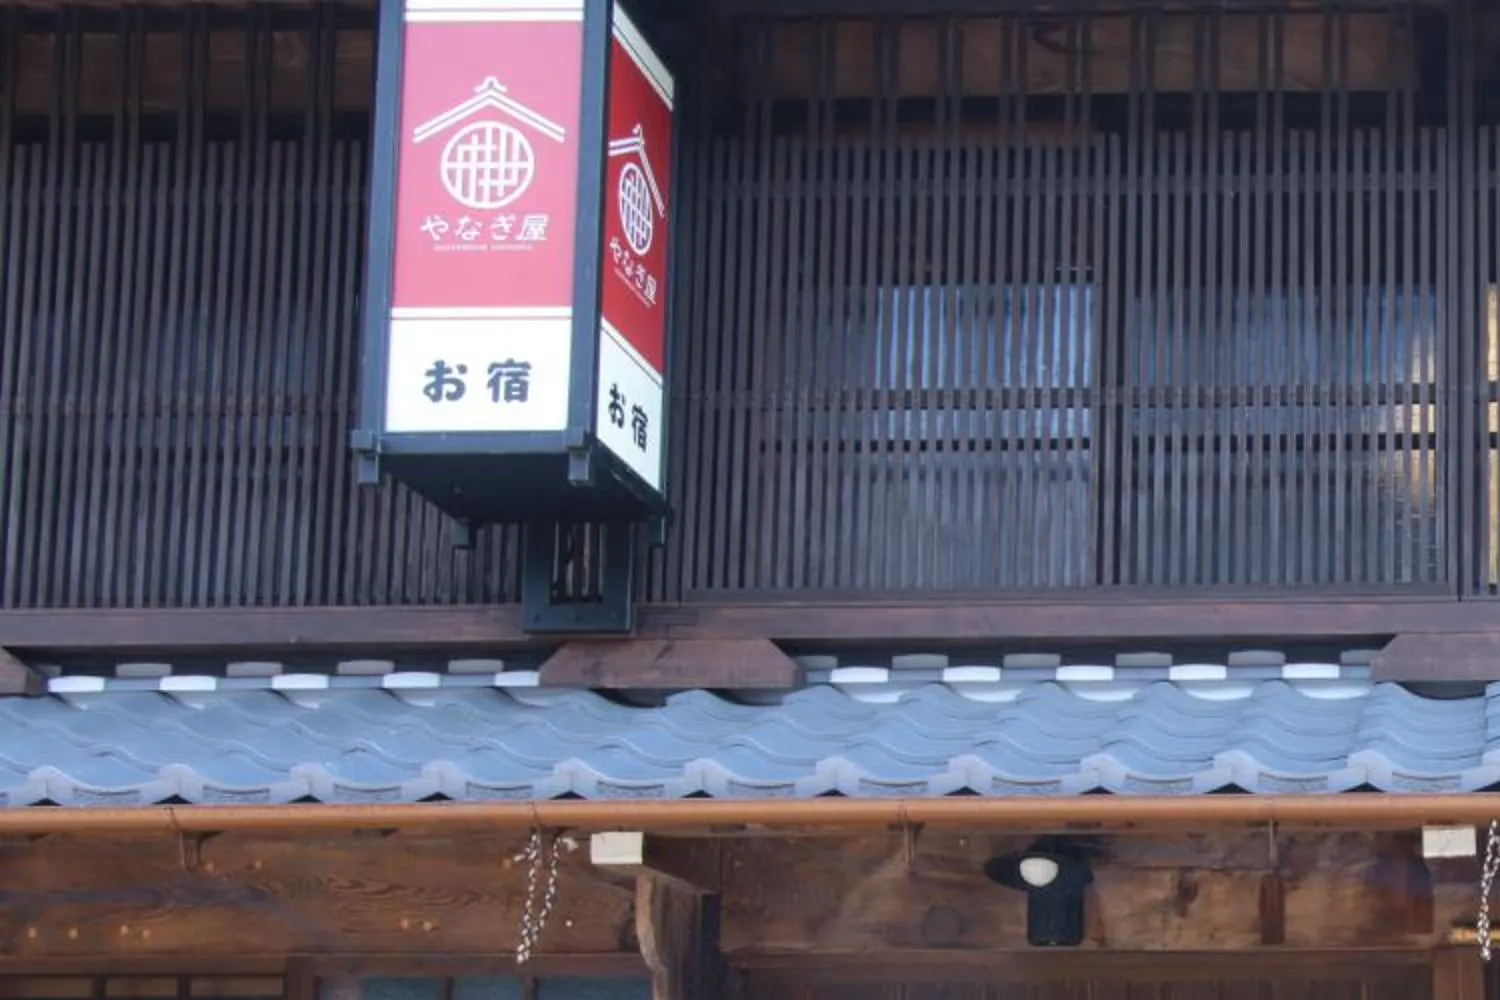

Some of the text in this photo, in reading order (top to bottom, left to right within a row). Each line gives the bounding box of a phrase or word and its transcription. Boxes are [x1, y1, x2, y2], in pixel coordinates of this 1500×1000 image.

[420, 213, 549, 241] やなぎ屋
[422, 358, 532, 403] お宿
[607, 382, 648, 453] お宿
